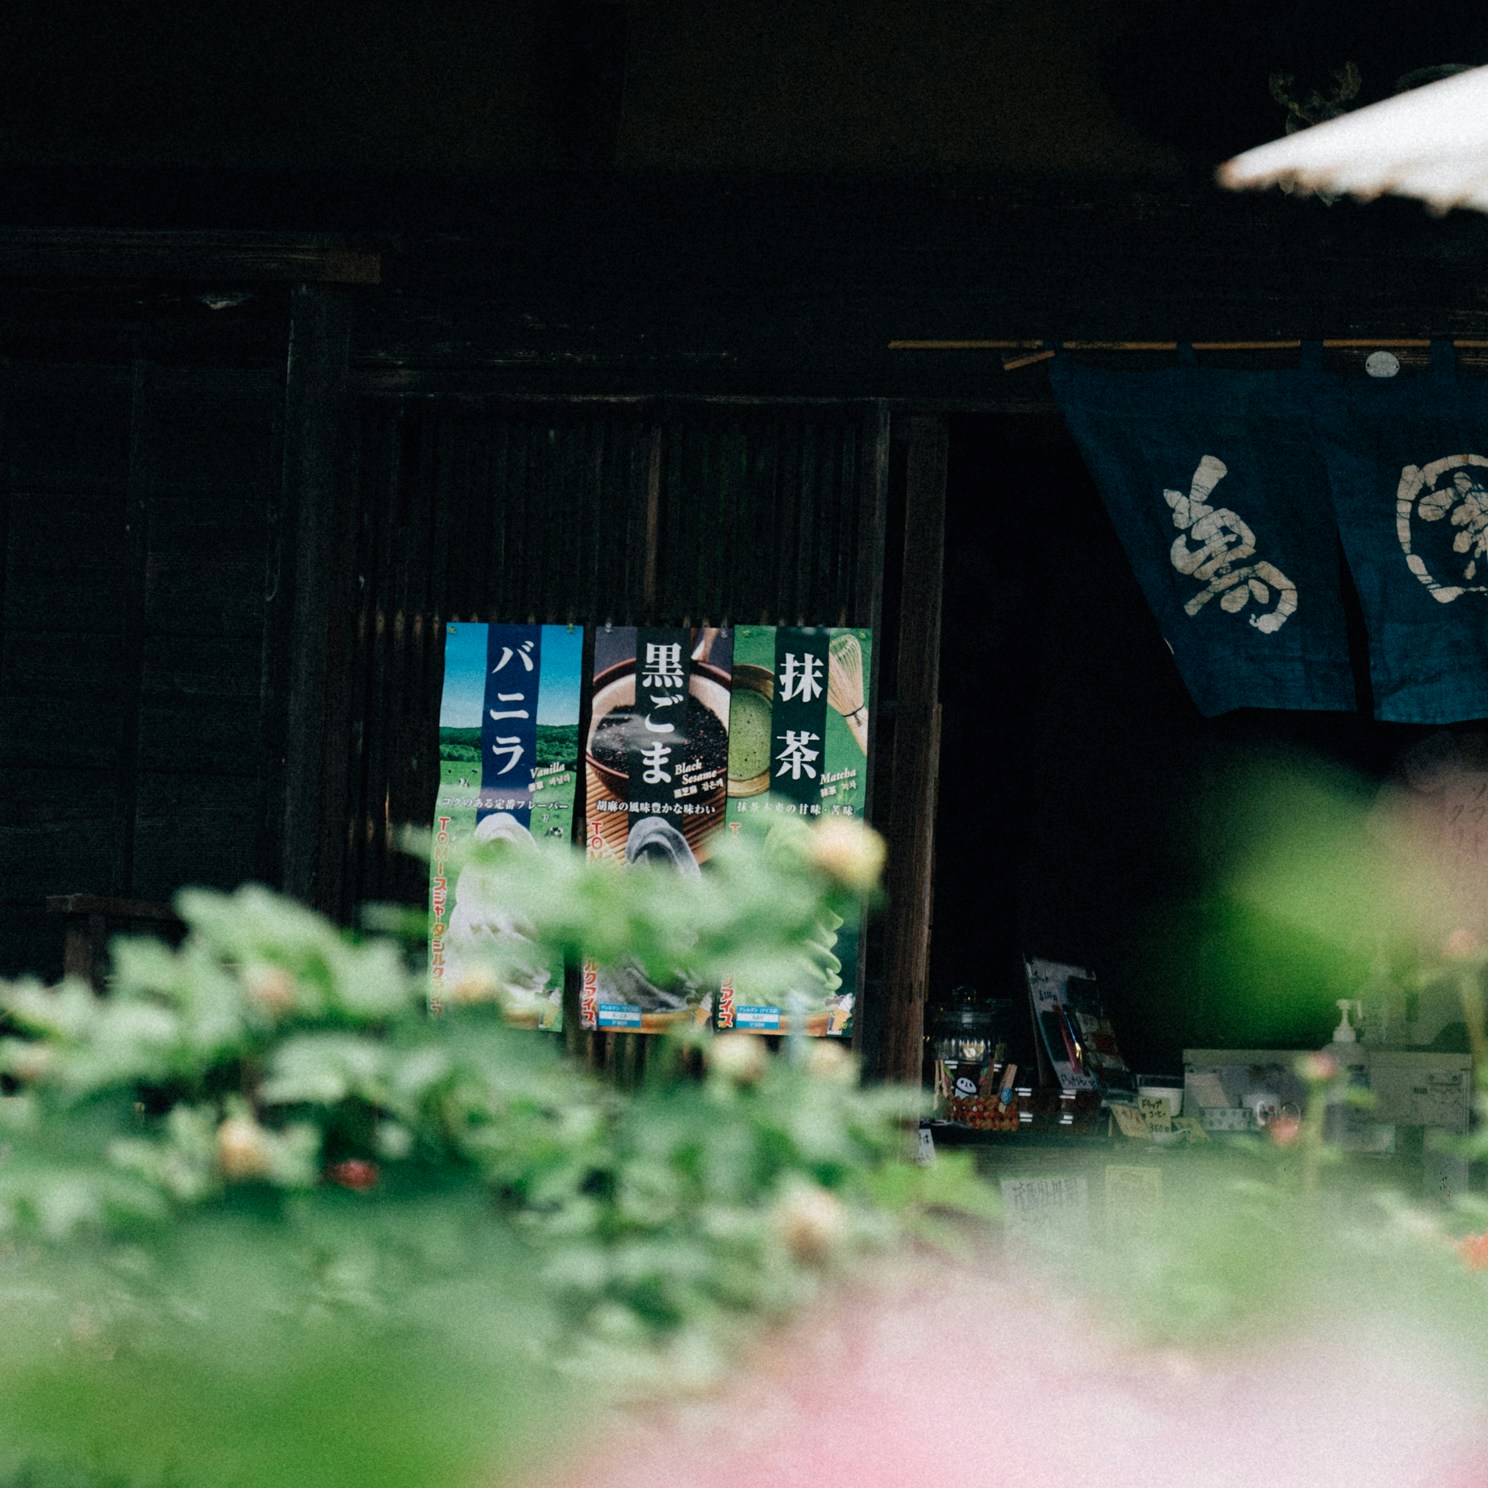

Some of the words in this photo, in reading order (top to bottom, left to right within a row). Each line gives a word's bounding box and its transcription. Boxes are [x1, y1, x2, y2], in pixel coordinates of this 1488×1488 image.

[489, 639, 536, 776] バニラ
[640, 641, 685, 785] 黒ごま
[775, 652, 825, 781] 抹茶
[530, 761, 566, 779] Vanilla
[674, 758, 703, 776] Black
[819, 767, 857, 785] Matcha
[681, 769, 718, 785] Sesame
[596, 799, 715, 815] 胡麻の風味豊かな味わい
